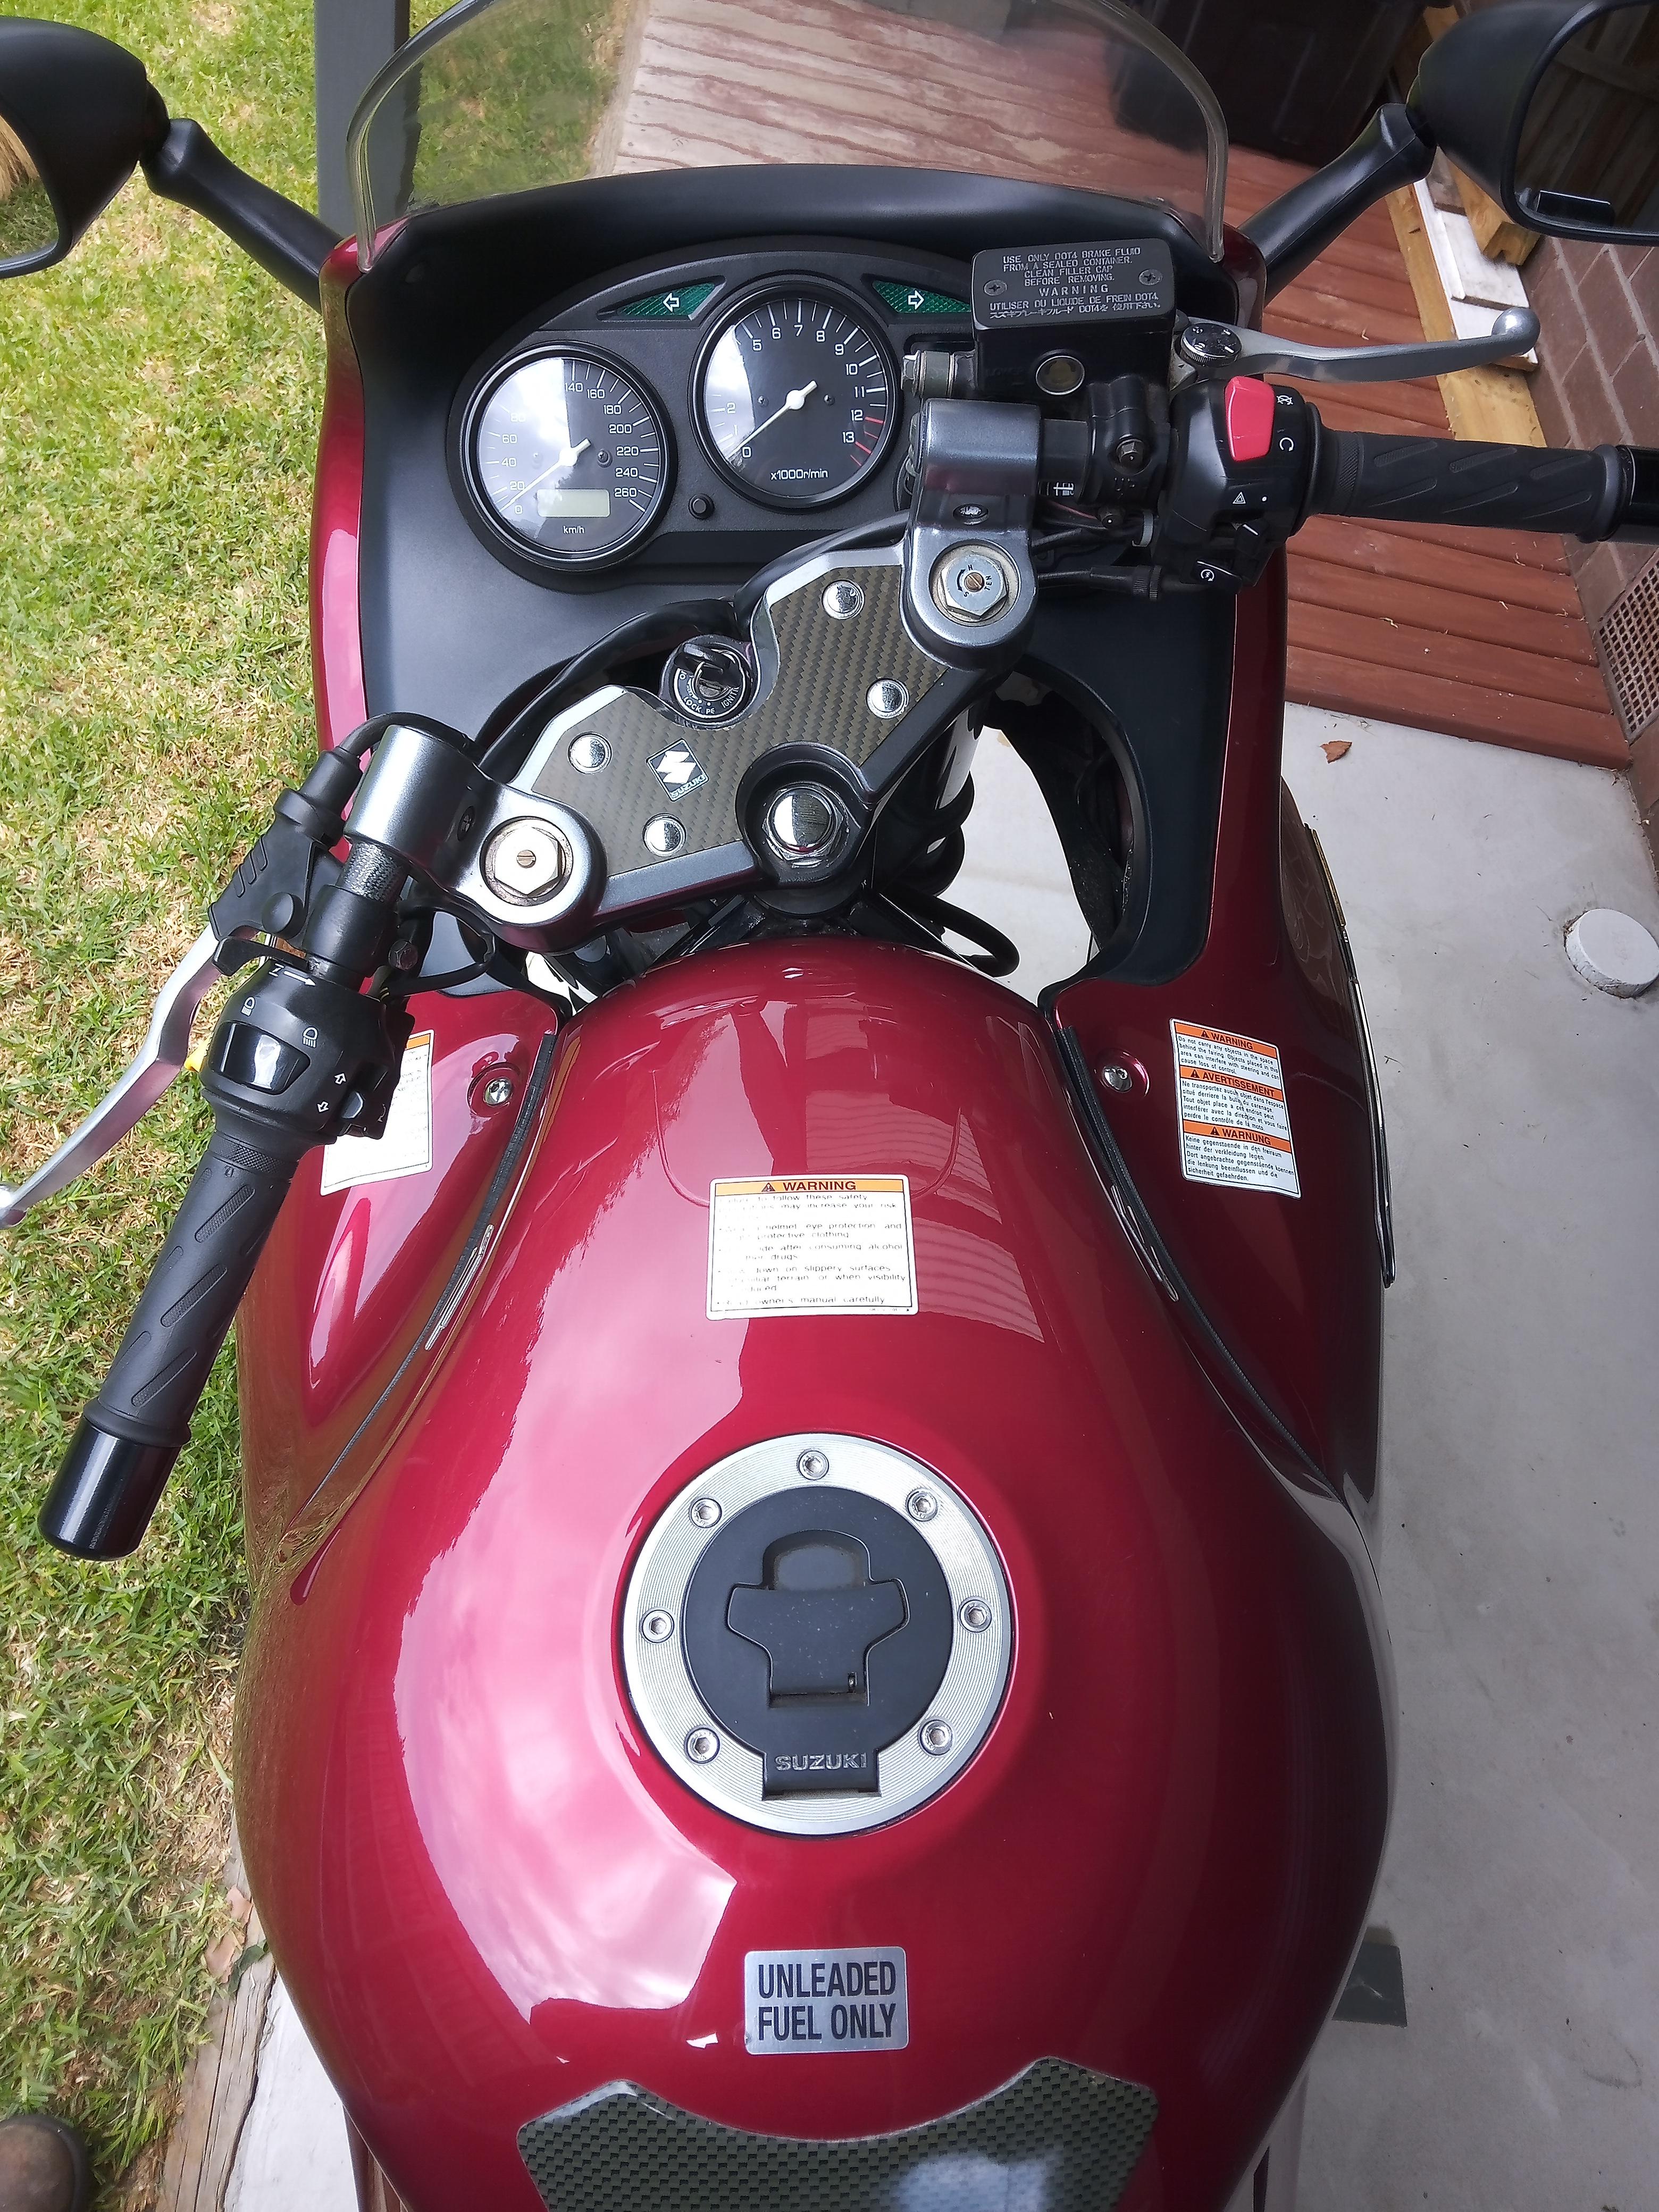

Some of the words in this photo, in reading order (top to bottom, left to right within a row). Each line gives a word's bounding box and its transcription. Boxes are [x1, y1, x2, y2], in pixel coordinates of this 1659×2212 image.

[1003, 255, 1021, 264] USE
[1028, 253, 1050, 262] ONLY
[1055, 251, 1077, 259] DOT4
[1082, 249, 1111, 258] BRAKE
[1115, 247, 1140, 256] FLUID
[1003, 263, 1028, 272] FROM
[1043, 259, 1078, 269] SEALED
[1084, 256, 1133, 266] CONTAINER.
[1024, 269, 1053, 278] CLEAN
[1059, 266, 1091, 275] FILLER
[1025, 276, 1060, 286] BEFORE
[1068, 273, 1115, 283] REMOVING.
[1039, 284, 1108, 297] WARNING
[990, 301, 1029, 311] UTILISER
[1051, 297, 1084, 306] LIQUIDE
[1089, 296, 1101, 304] DE
[1106, 294, 1132, 303] FREIN
[1135, 292, 1159, 301] DOT4.
[772, 328, 781, 340] 6
[794, 325, 803, 336] 7
[816, 330, 826, 342] 8
[752, 339, 762, 351] 5
[835, 343, 844, 355] 9
[846, 363, 858, 375] 10
[565, 382, 583, 392] 140
[854, 386, 866, 398] 11
[587, 389, 605, 399] 160
[604, 405, 622, 415] 180
[726, 402, 736, 414] 2
[851, 409, 863, 421] 12
[609, 424, 632, 434] 200
[502, 434, 517, 444] 60
[842, 431, 854, 443] 13
[616, 446, 639, 456] 220
[742, 447, 752, 458] 0
[501, 458, 517, 467] 40
[615, 468, 638, 477] 240
[770, 468, 828, 480] x1000r/min
[509, 481, 525, 491] 20
[614, 488, 637, 498] 260
[515, 505, 523, 515] 0
[563, 525, 584, 534] km/h
[683, 697, 702, 713] LOCK
[669, 773, 706, 798] SUZUKI
[1211, 1033, 1253, 1050] WARNING
[1227, 1054, 1245, 1063] Objects
[1205, 1056, 1226, 1065] interfere
[1241, 1065, 1259, 1075] steering
[1192, 1083, 1222, 1092] transportez
[1203, 1072, 1274, 1096] AVERTISSEMENT
[1186, 1135, 1200, 1143] Keine
[1203, 1139, 1240, 1149] gegenstaende
[1222, 1128, 1271, 1145] WARNUNG
[1215, 1149, 1246, 1158] verkleidung
[1197, 1160, 1218, 1170] lenkung
[1221, 1164, 1255, 1174] beeinflussen
[1201, 1154, 1234, 1163] angebrachte
[1237, 1160, 1273, 1170] gegenstaende
[1188, 1167, 1213, 1176] sicherheit
[1217, 1172, 1249, 1181] gefaehrden.
[783, 1182, 856, 1191] WARNING
[775, 1753, 867, 1770] SUZUKI
[758, 1961, 896, 1998] UNLEADED
[758, 2005, 822, 2041] FUEL
[831, 2002, 896, 2040] ONLY
